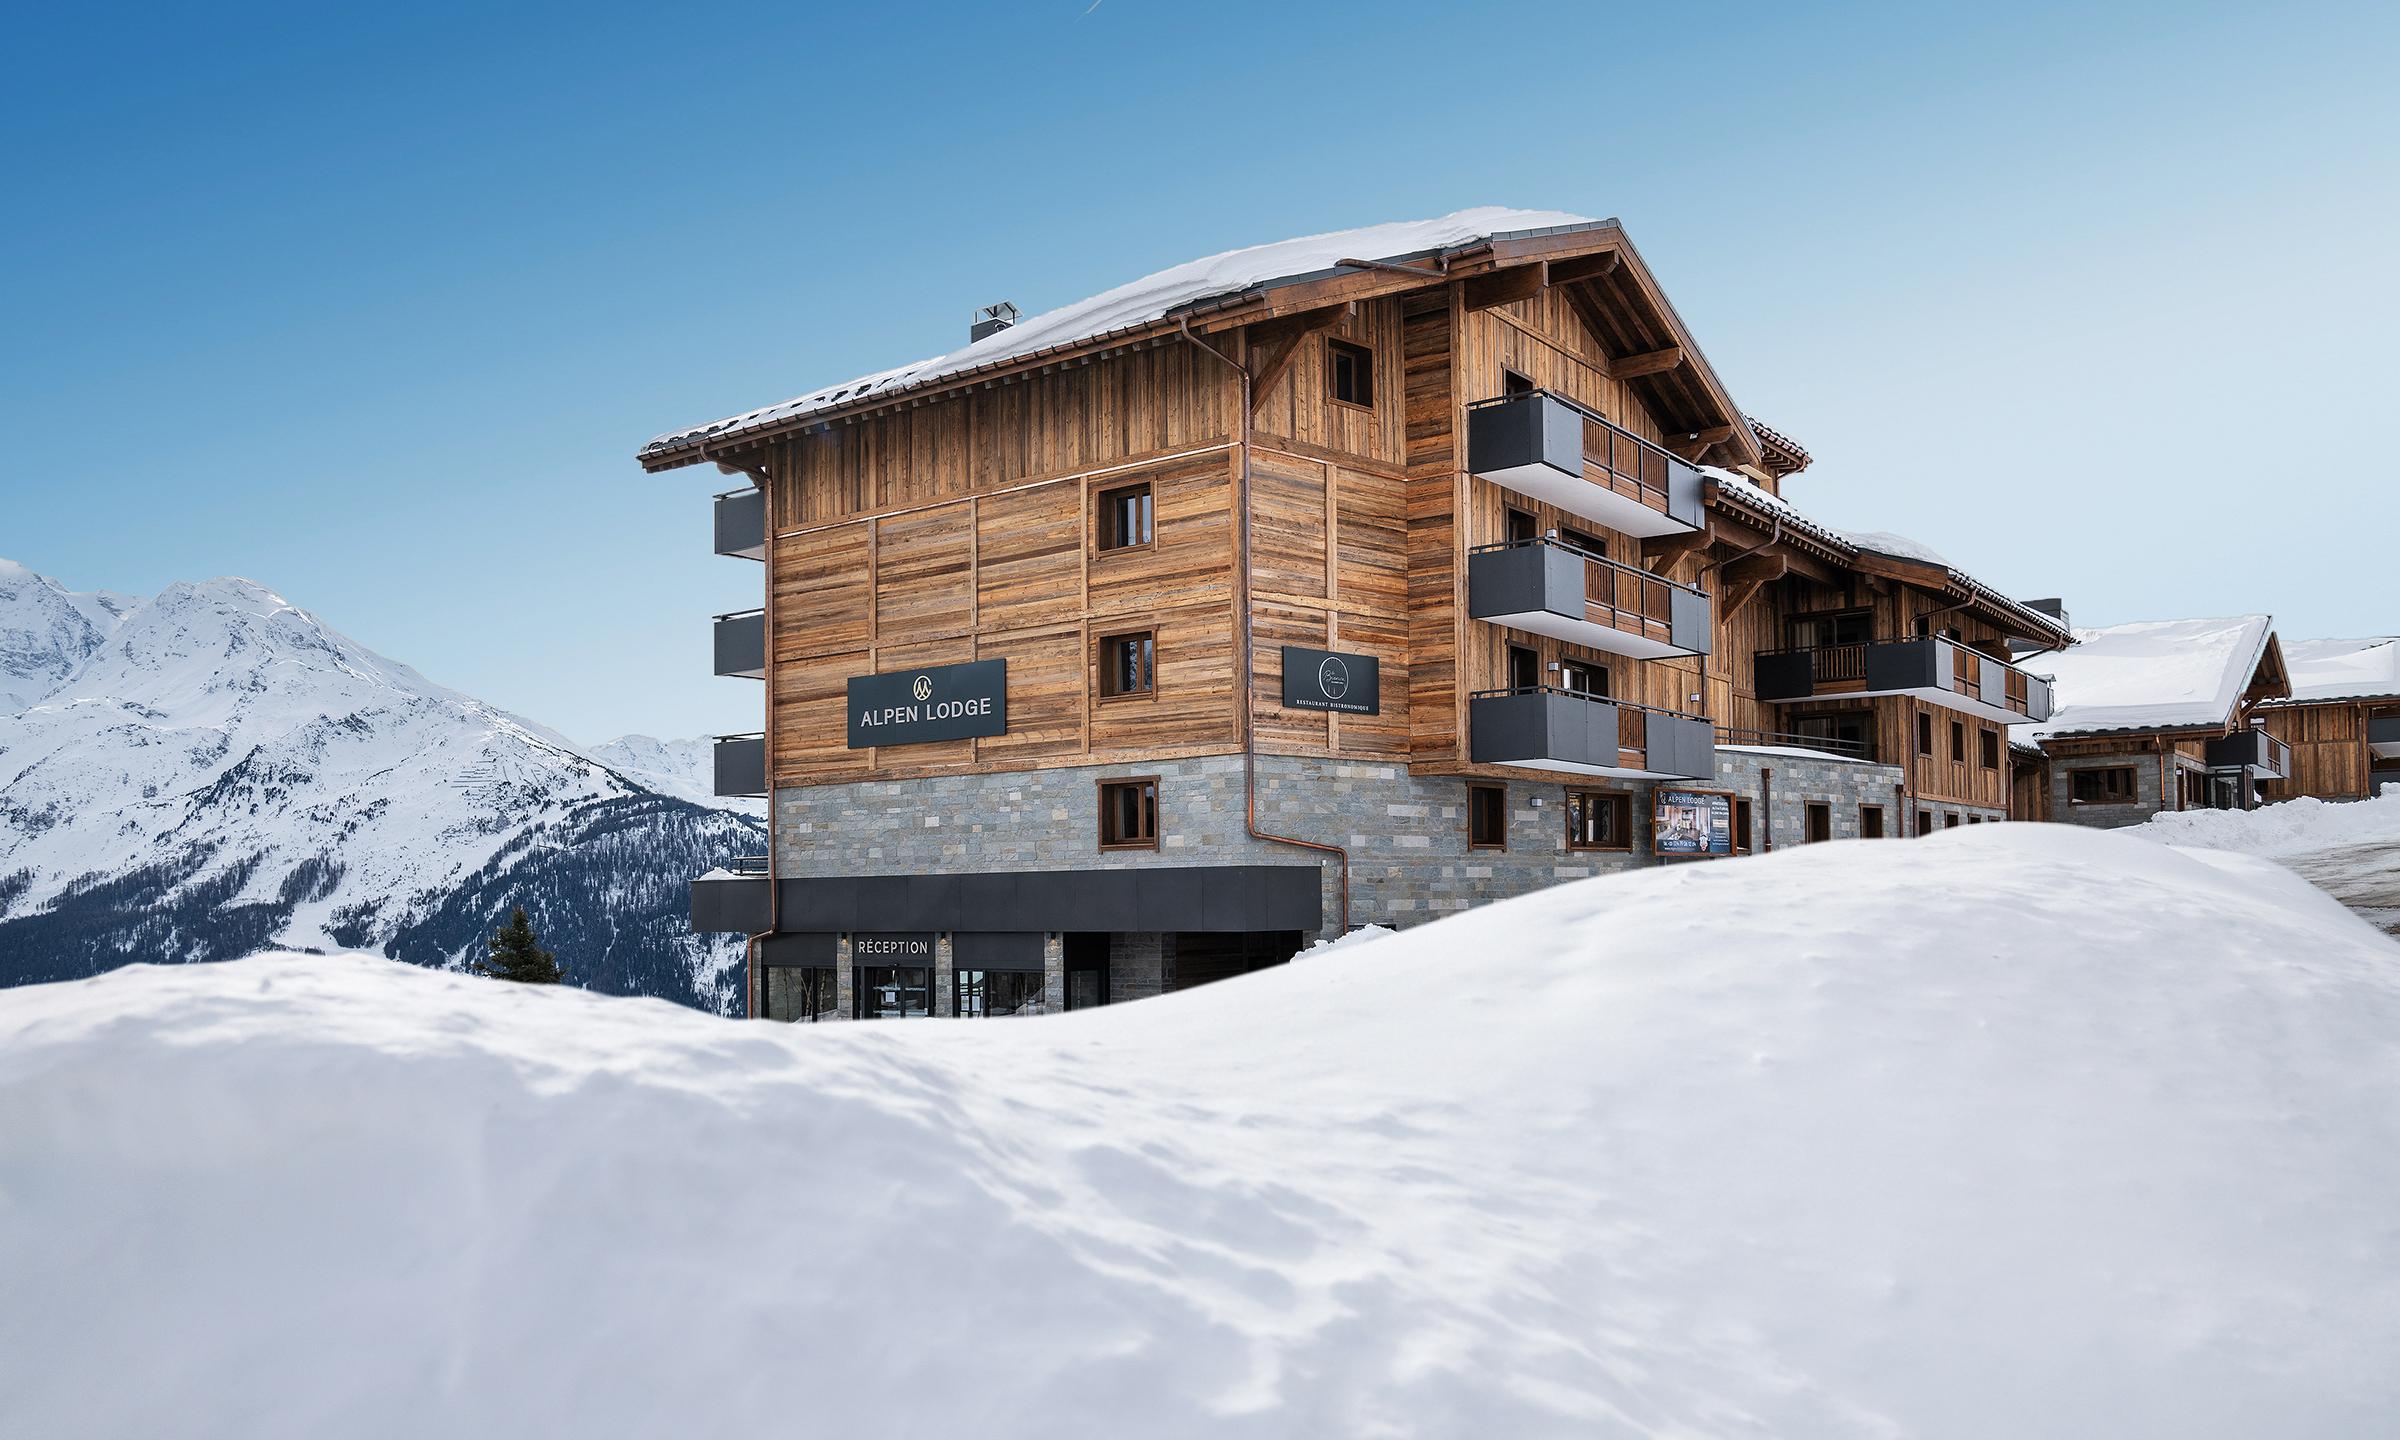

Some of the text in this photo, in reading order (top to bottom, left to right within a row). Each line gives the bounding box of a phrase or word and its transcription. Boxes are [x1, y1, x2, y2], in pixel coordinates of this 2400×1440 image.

[1296, 699, 1369, 711] RESTAURANT BISTRONOMIQUE
[861, 697, 992, 728] ALPEN LODGE
[1668, 796, 1705, 805] ALPEN LODGE
[858, 938, 928, 954] RÉCEPTION
